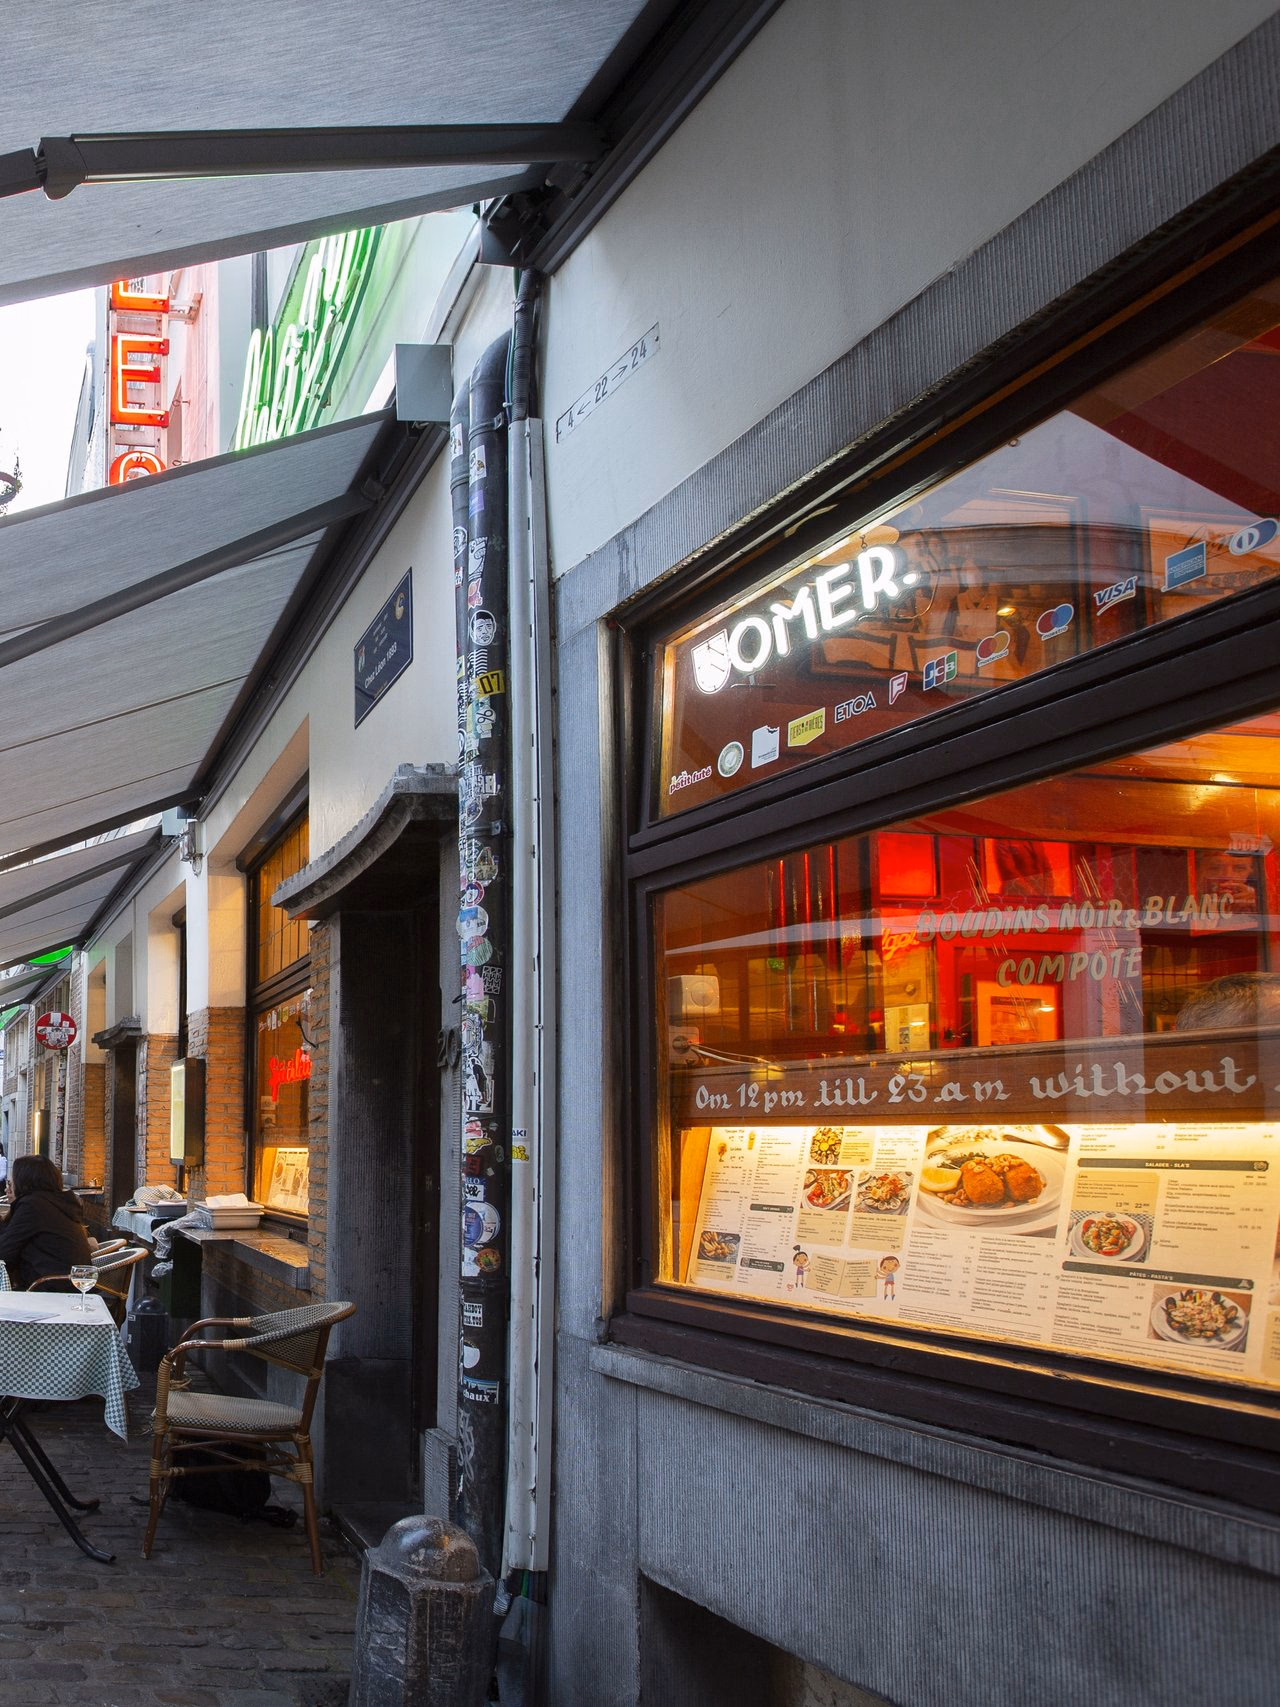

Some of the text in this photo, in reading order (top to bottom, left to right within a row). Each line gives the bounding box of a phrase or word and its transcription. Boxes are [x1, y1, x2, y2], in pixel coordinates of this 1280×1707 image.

[594, 375, 608, 404] 22
[631, 339, 648, 370] 24
[1094, 576, 1138, 606] VISA
[925, 658, 956, 683] JCB
[834, 691, 877, 724] ETOA
[669, 766, 712, 795] petit futé
[1143, 892, 1234, 927] BLANC
[996, 946, 1143, 988] COMPOTE
[813, 1076, 878, 1108] till
[1028, 1056, 1257, 1100] without
